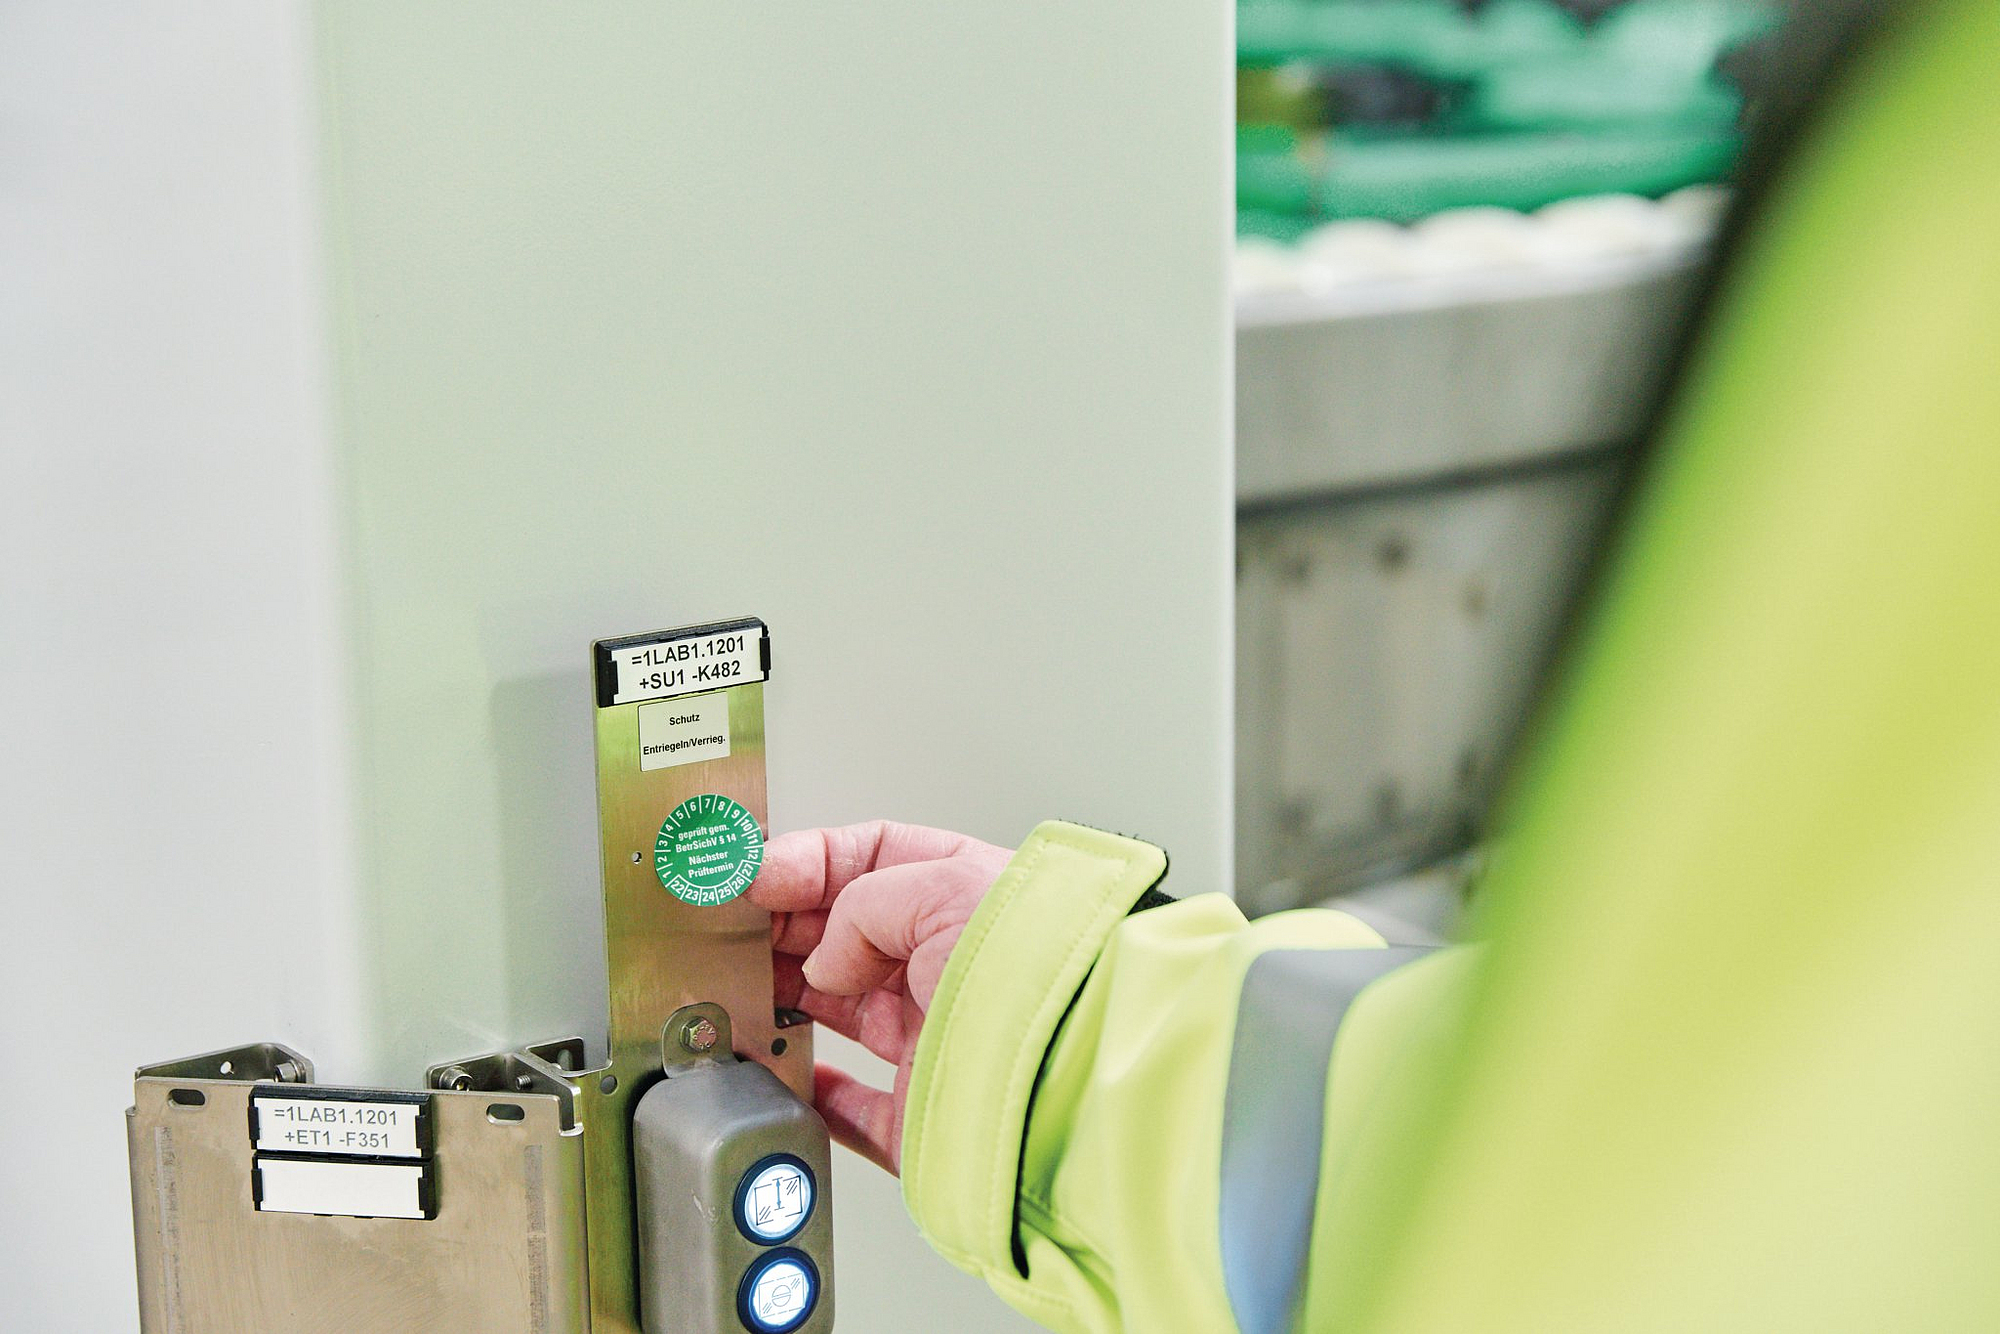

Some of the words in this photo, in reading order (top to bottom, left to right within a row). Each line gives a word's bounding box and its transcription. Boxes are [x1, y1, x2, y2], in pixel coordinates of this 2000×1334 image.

[631, 635, 744, 667] =1LAB1.1201
[639, 669, 684, 690] +SU1
[692, 660, 741, 682] -K482
[669, 713, 700, 726] Schutz
[643, 734, 726, 755] Entriegeln/Verrieg.
[690, 802, 696, 811] 6
[705, 799, 710, 808] 7
[718, 801, 725, 811] 8
[676, 810, 684, 819] 5
[731, 810, 740, 819] 9
[665, 824, 674, 832] 4
[741, 819, 752, 831] 10
[678, 826, 707, 841] geprüft
[709, 824, 730, 836] gem.
[747, 834, 758, 844] 11
[676, 837, 717, 852] BetrSichV
[719, 836, 724, 844] §
[727, 834, 736, 842] 14
[688, 851, 728, 865] Nächster
[748, 850, 759, 860] 12
[688, 863, 734, 878] Prüftermin
[671, 880, 684, 893] 22
[685, 890, 698, 900] 23
[702, 892, 715, 902] 24
[718, 889, 731, 899] 25
[732, 877, 745, 890] 26
[742, 863, 754, 876] 27
[274, 1106, 397, 1126] =1LAB1.1201
[284, 1130, 331, 1146] +ET1
[339, 1132, 389, 1148] -F351
